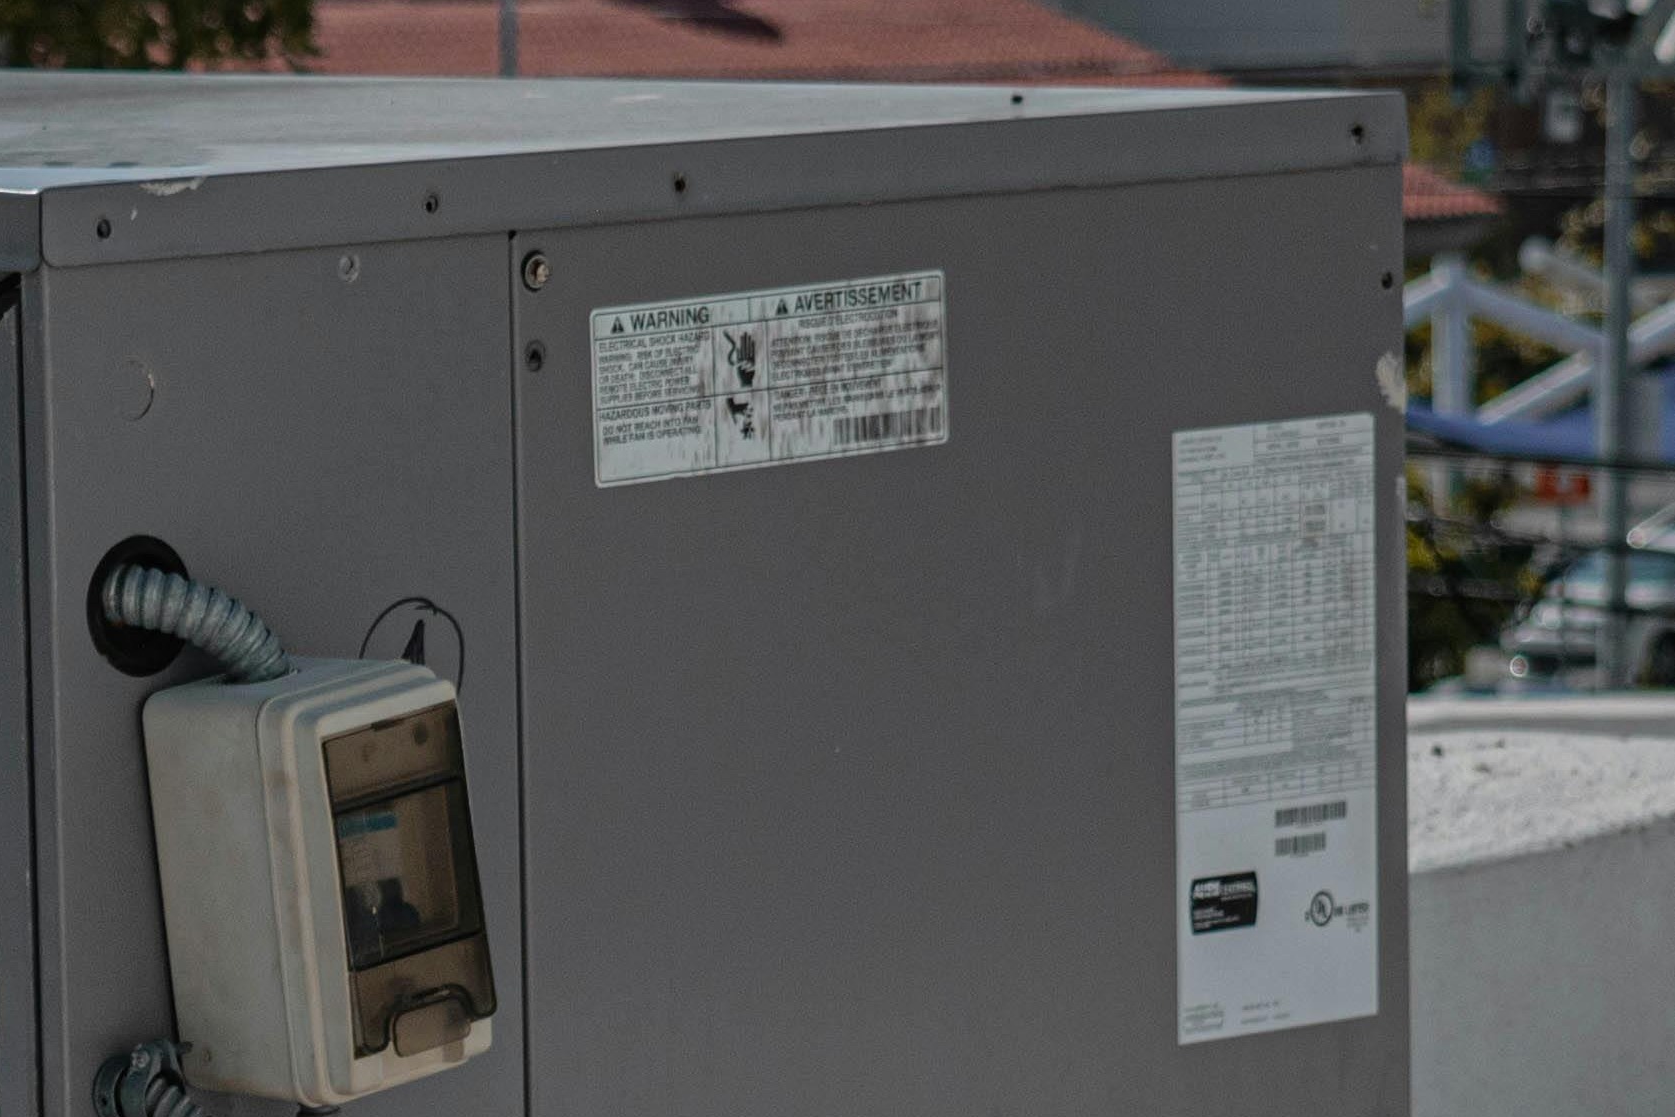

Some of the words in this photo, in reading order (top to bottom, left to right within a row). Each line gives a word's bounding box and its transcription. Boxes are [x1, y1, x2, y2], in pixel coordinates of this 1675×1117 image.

[794, 281, 922, 314] AVERTISSEMENT
[631, 306, 710, 333] WARNING
[601, 407, 650, 422] HAZARDOUS
